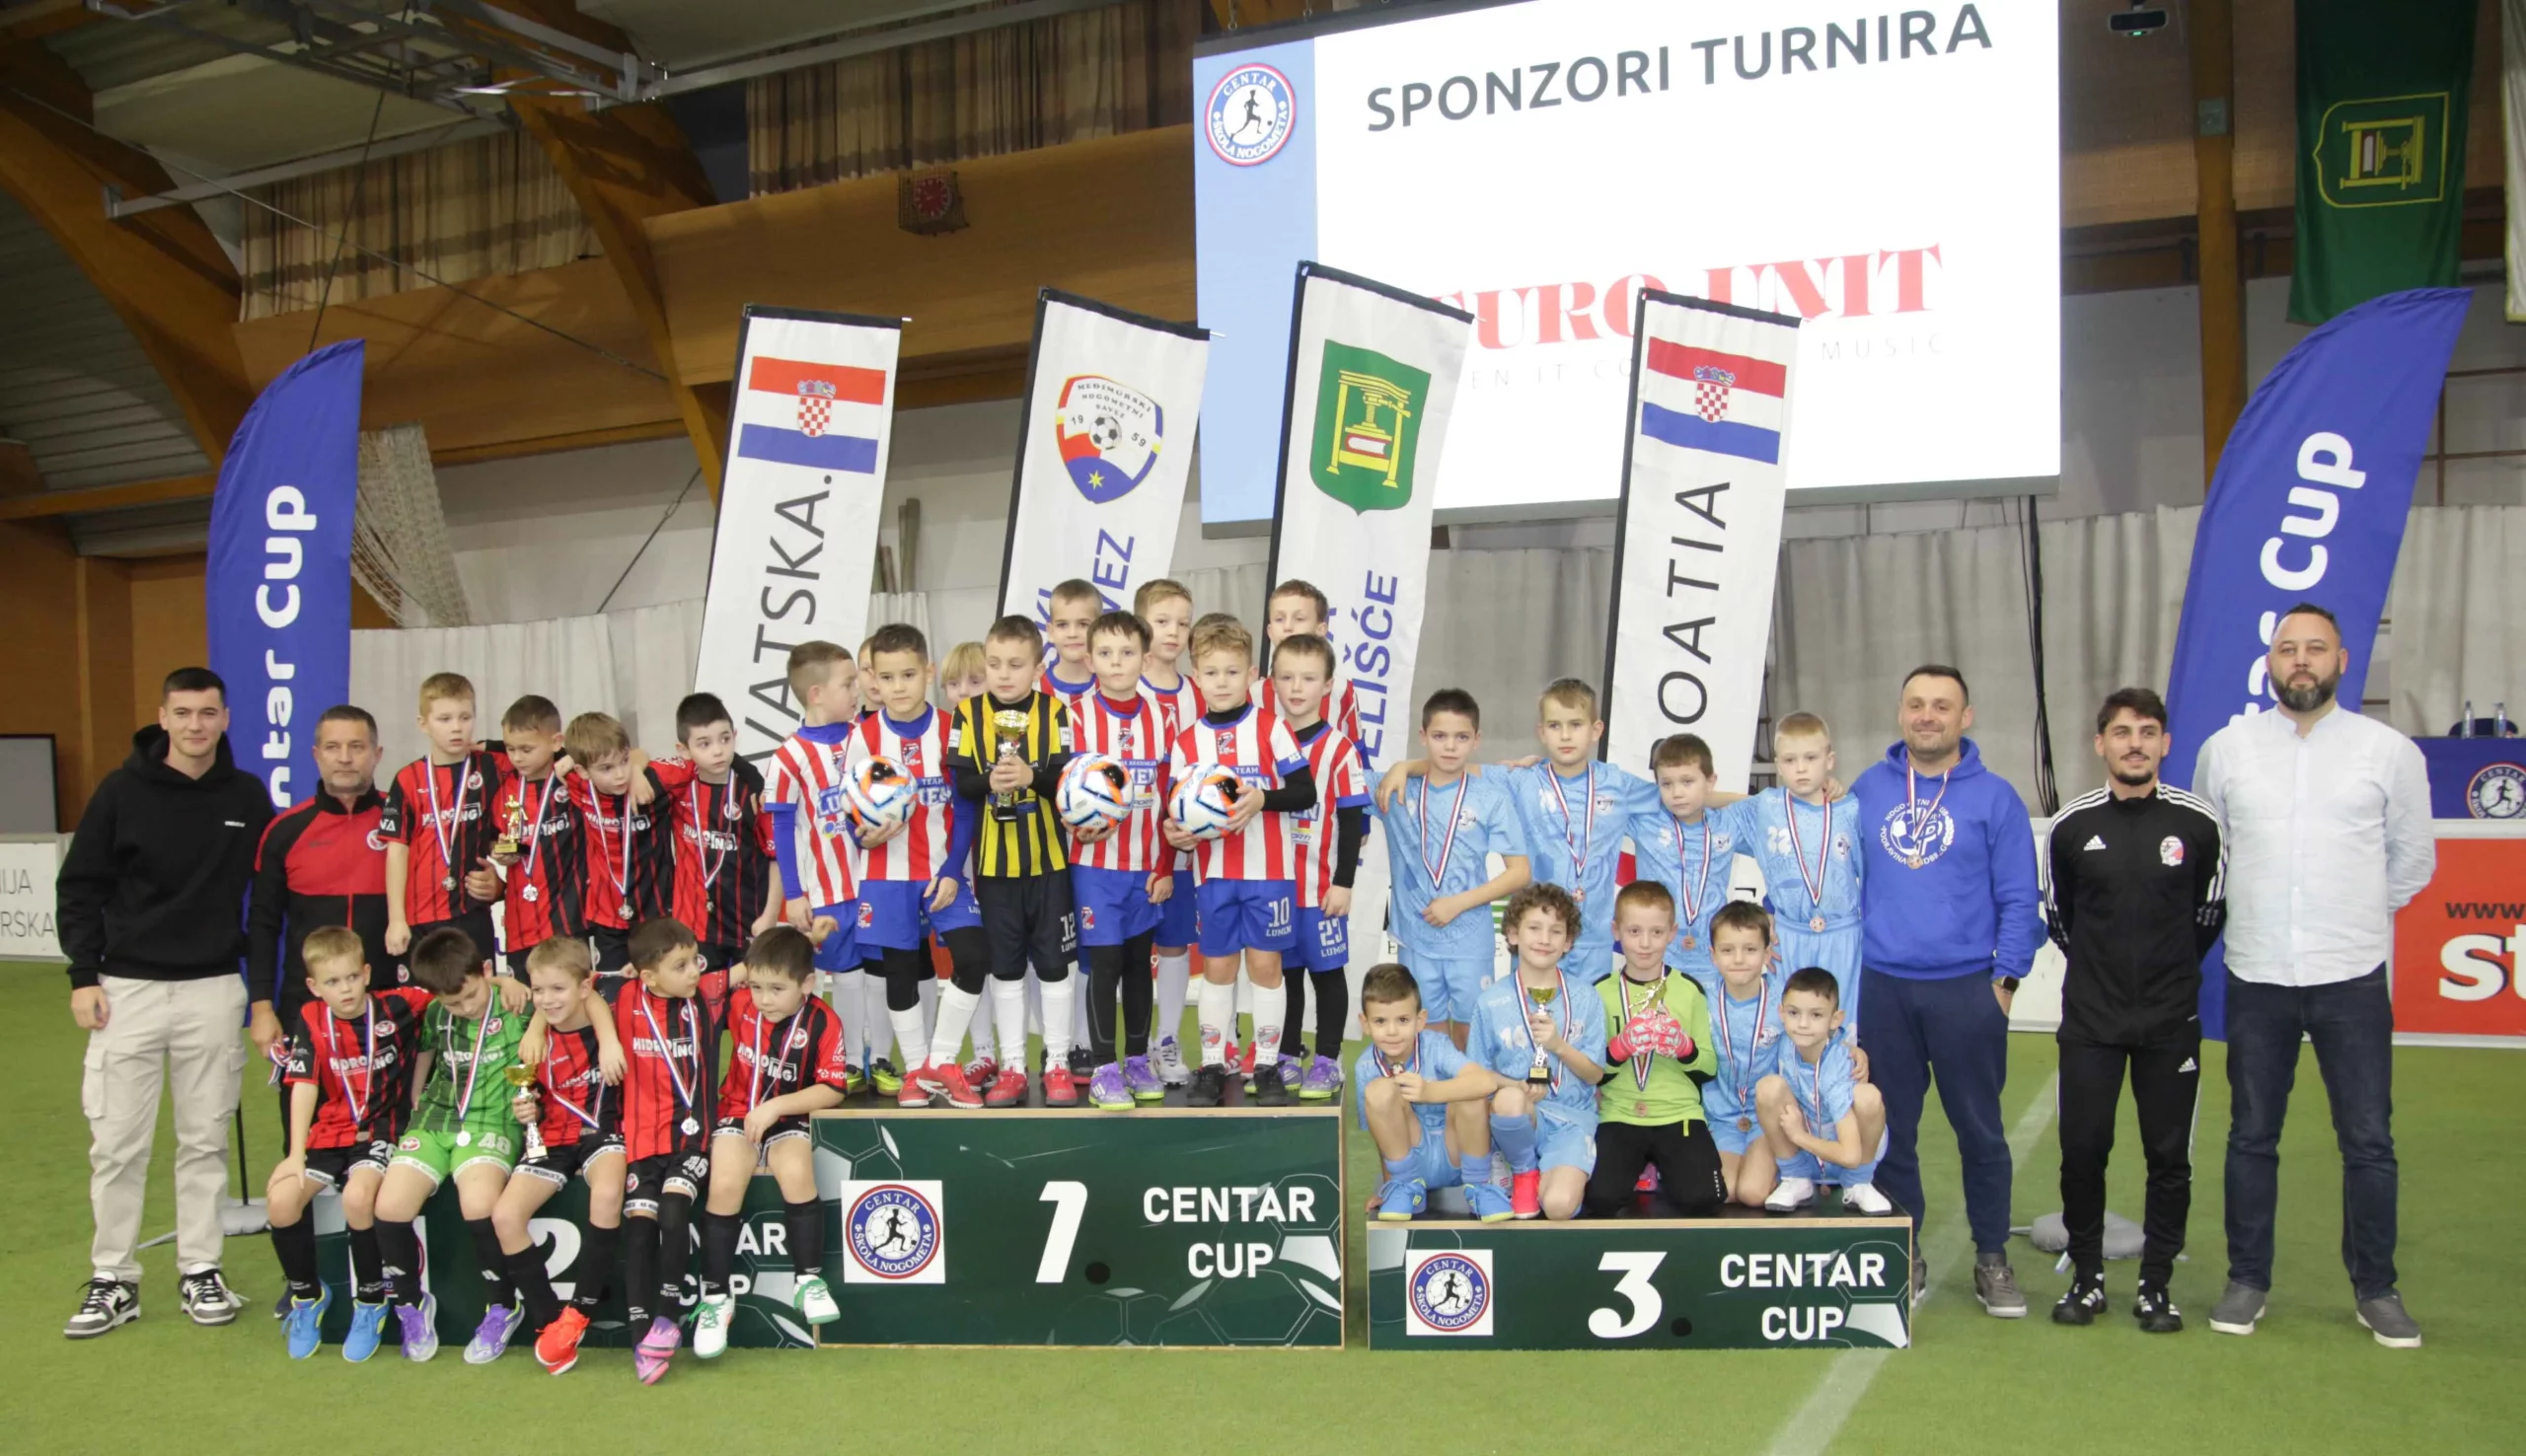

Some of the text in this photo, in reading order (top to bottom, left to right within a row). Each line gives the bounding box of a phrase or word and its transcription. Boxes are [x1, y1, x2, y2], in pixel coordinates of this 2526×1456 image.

[1367, 2, 1993, 132] SPONZORI TURNIRA
[1224, 72, 1277, 97] CENTAR
[1236, 110, 1288, 158] NOGOMETA
[1821, 331, 1944, 362] MUSIC
[1072, 414, 1147, 447] 19 59
[2260, 431, 2366, 591] Cup
[256, 484, 318, 629] Cup
[1059, 911, 1077, 942] 12
[1267, 897, 1291, 928] 10
[864, 1193, 921, 1213] CENTAR
[1143, 1187, 1316, 1222] CENTAR
[879, 1233, 932, 1272] NOGOMETA
[1188, 1243, 1274, 1278] CUP
[1426, 1260, 1474, 1278] CENTAR
[1720, 1253, 1886, 1287] CENTAR
[1437, 1293, 1483, 1326] NOGOMETA
[1761, 1306, 1844, 1341] CUP
